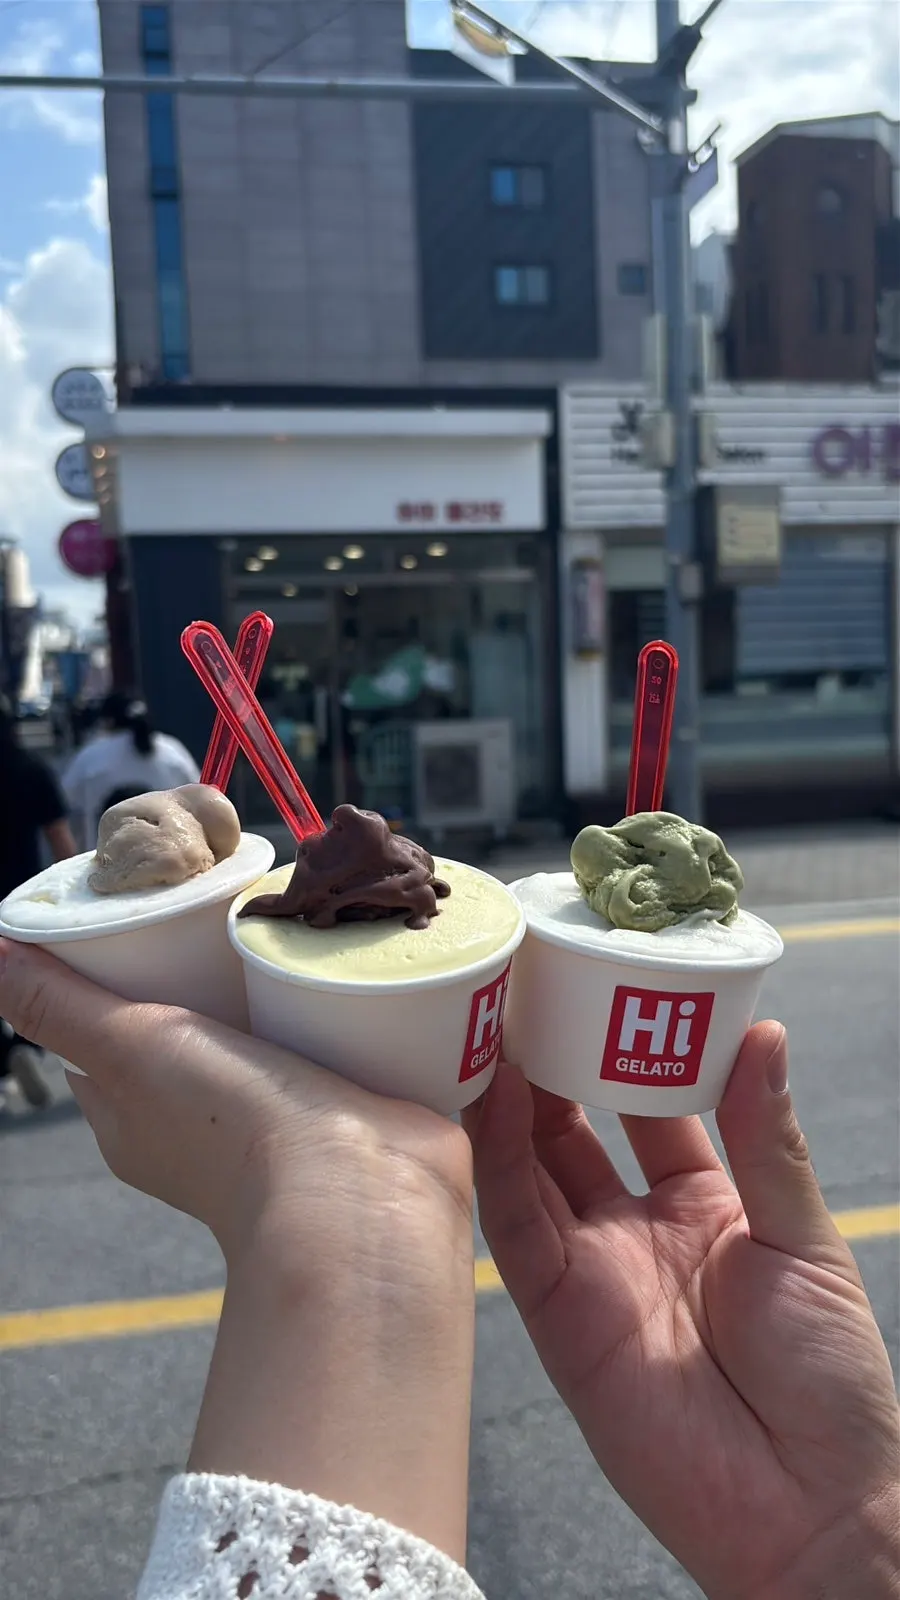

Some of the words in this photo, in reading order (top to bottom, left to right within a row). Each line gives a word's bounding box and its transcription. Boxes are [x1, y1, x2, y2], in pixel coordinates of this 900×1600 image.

[473, 971, 510, 1050] Hi
[618, 995, 697, 1057] Hi
[615, 1057, 685, 1076] GELATO
